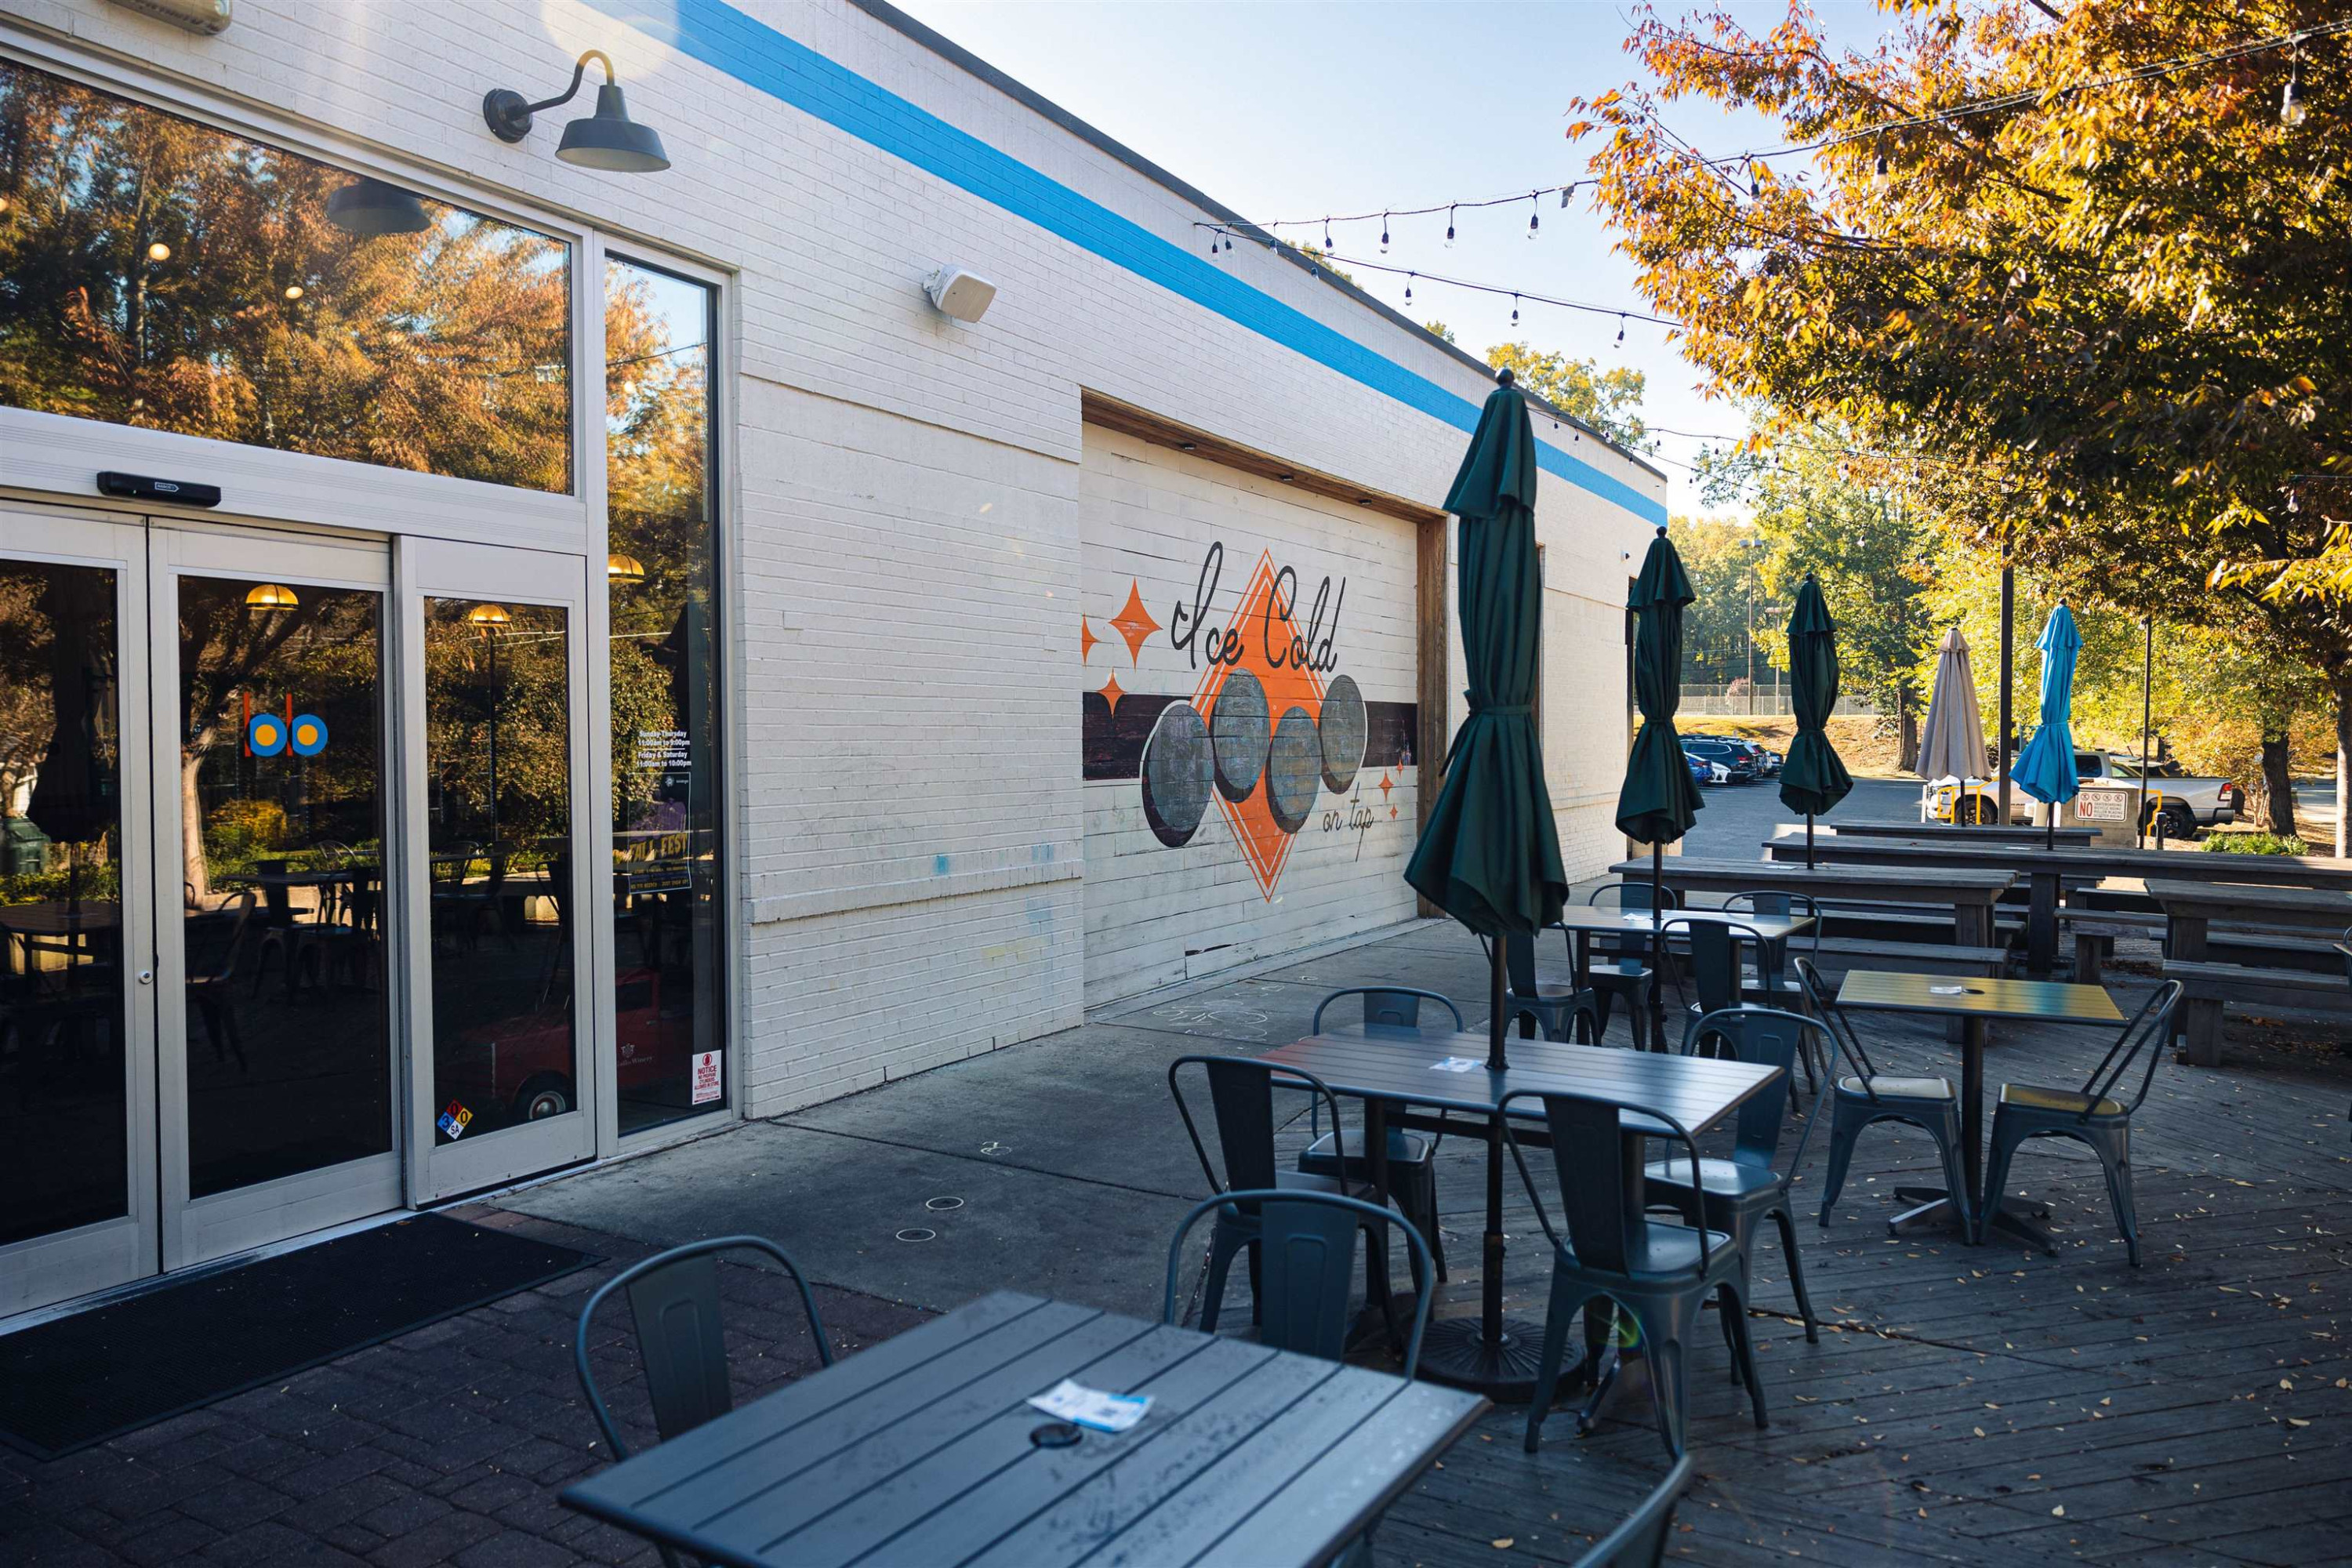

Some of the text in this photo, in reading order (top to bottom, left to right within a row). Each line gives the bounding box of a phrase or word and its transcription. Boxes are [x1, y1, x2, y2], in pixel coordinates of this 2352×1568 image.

[1171, 541, 1346, 673] Ice Cold
[670, 739, 690, 747] 9:00pm
[637, 751, 656, 760] Friday
[662, 750, 688, 759] Saturday
[668, 759, 691, 768] 10:00pm
[2079, 801, 2092, 817] NO
[1323, 782, 1374, 863] on tap
[661, 833, 688, 858] FEST
[698, 1065, 717, 1075] NOTICE
[442, 1110, 468, 1128] 3 0
[451, 1124, 459, 1135] SA
